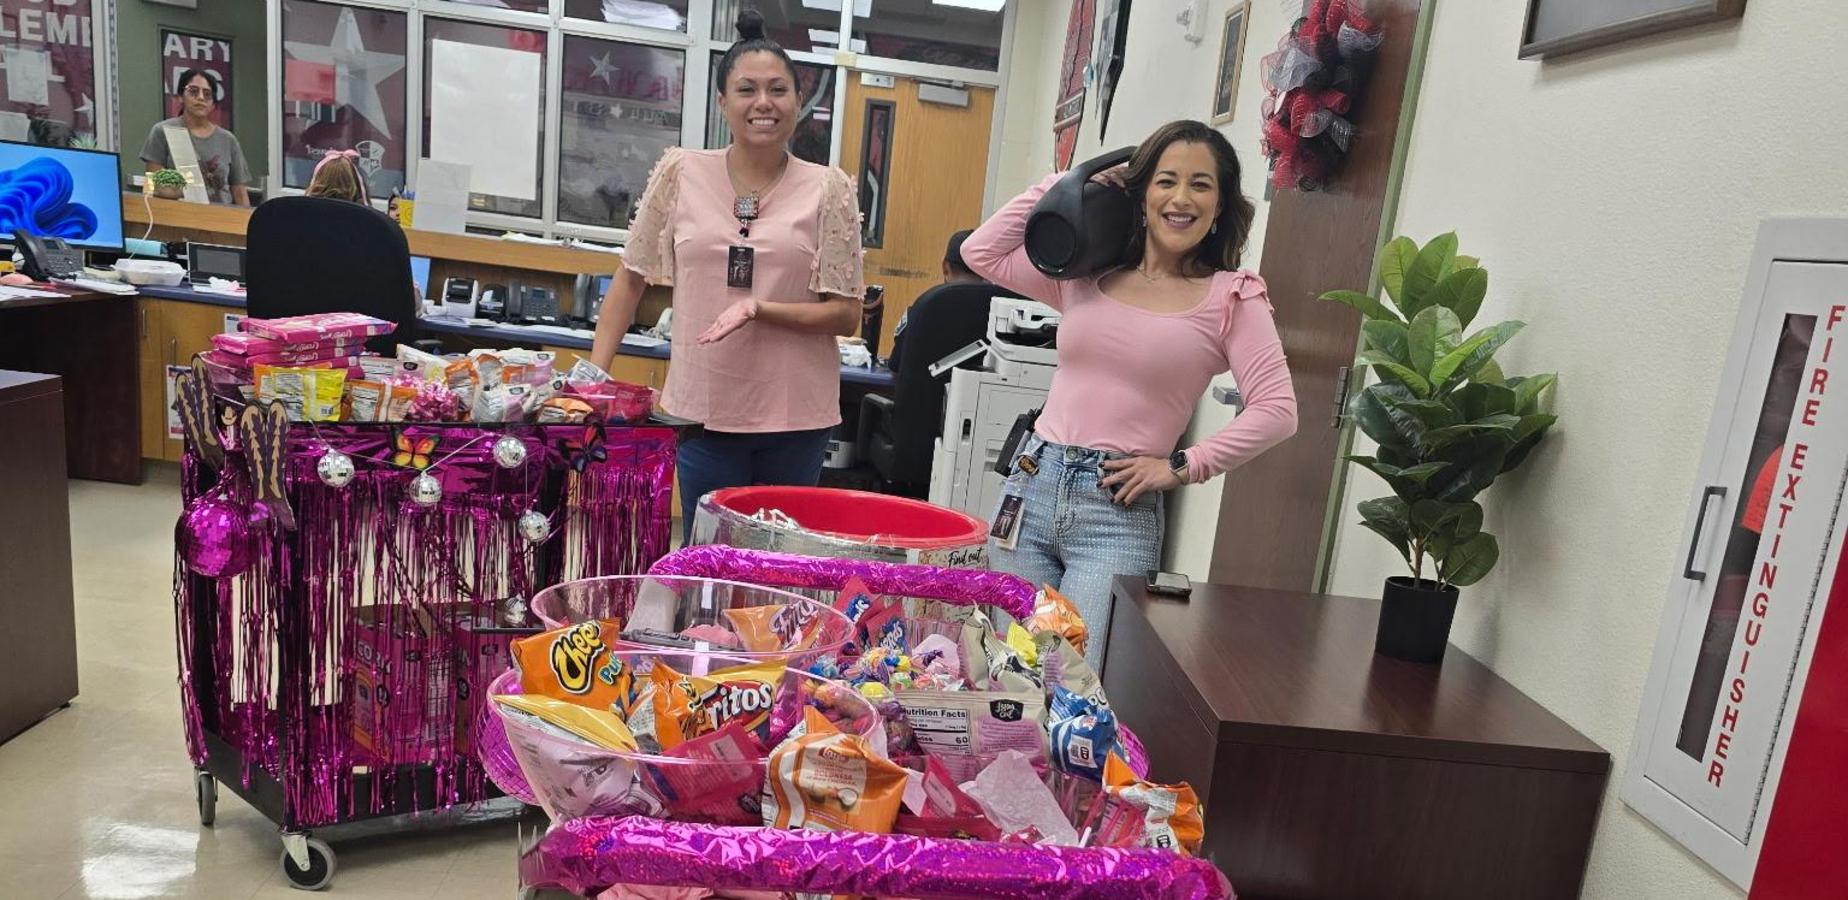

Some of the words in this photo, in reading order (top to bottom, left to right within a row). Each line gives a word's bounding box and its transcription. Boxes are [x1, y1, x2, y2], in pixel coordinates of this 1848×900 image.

[164, 33, 230, 62] ARY
[1802, 305, 1846, 426] FIRE
[948, 549, 967, 568] Find
[968, 546, 983, 563] out
[1708, 443, 1808, 788] EXTINGUISHER
[550, 620, 605, 693] Chee
[706, 681, 772, 731] ritos
[904, 708, 938, 717] utrition
[941, 709, 966, 718] Facts
